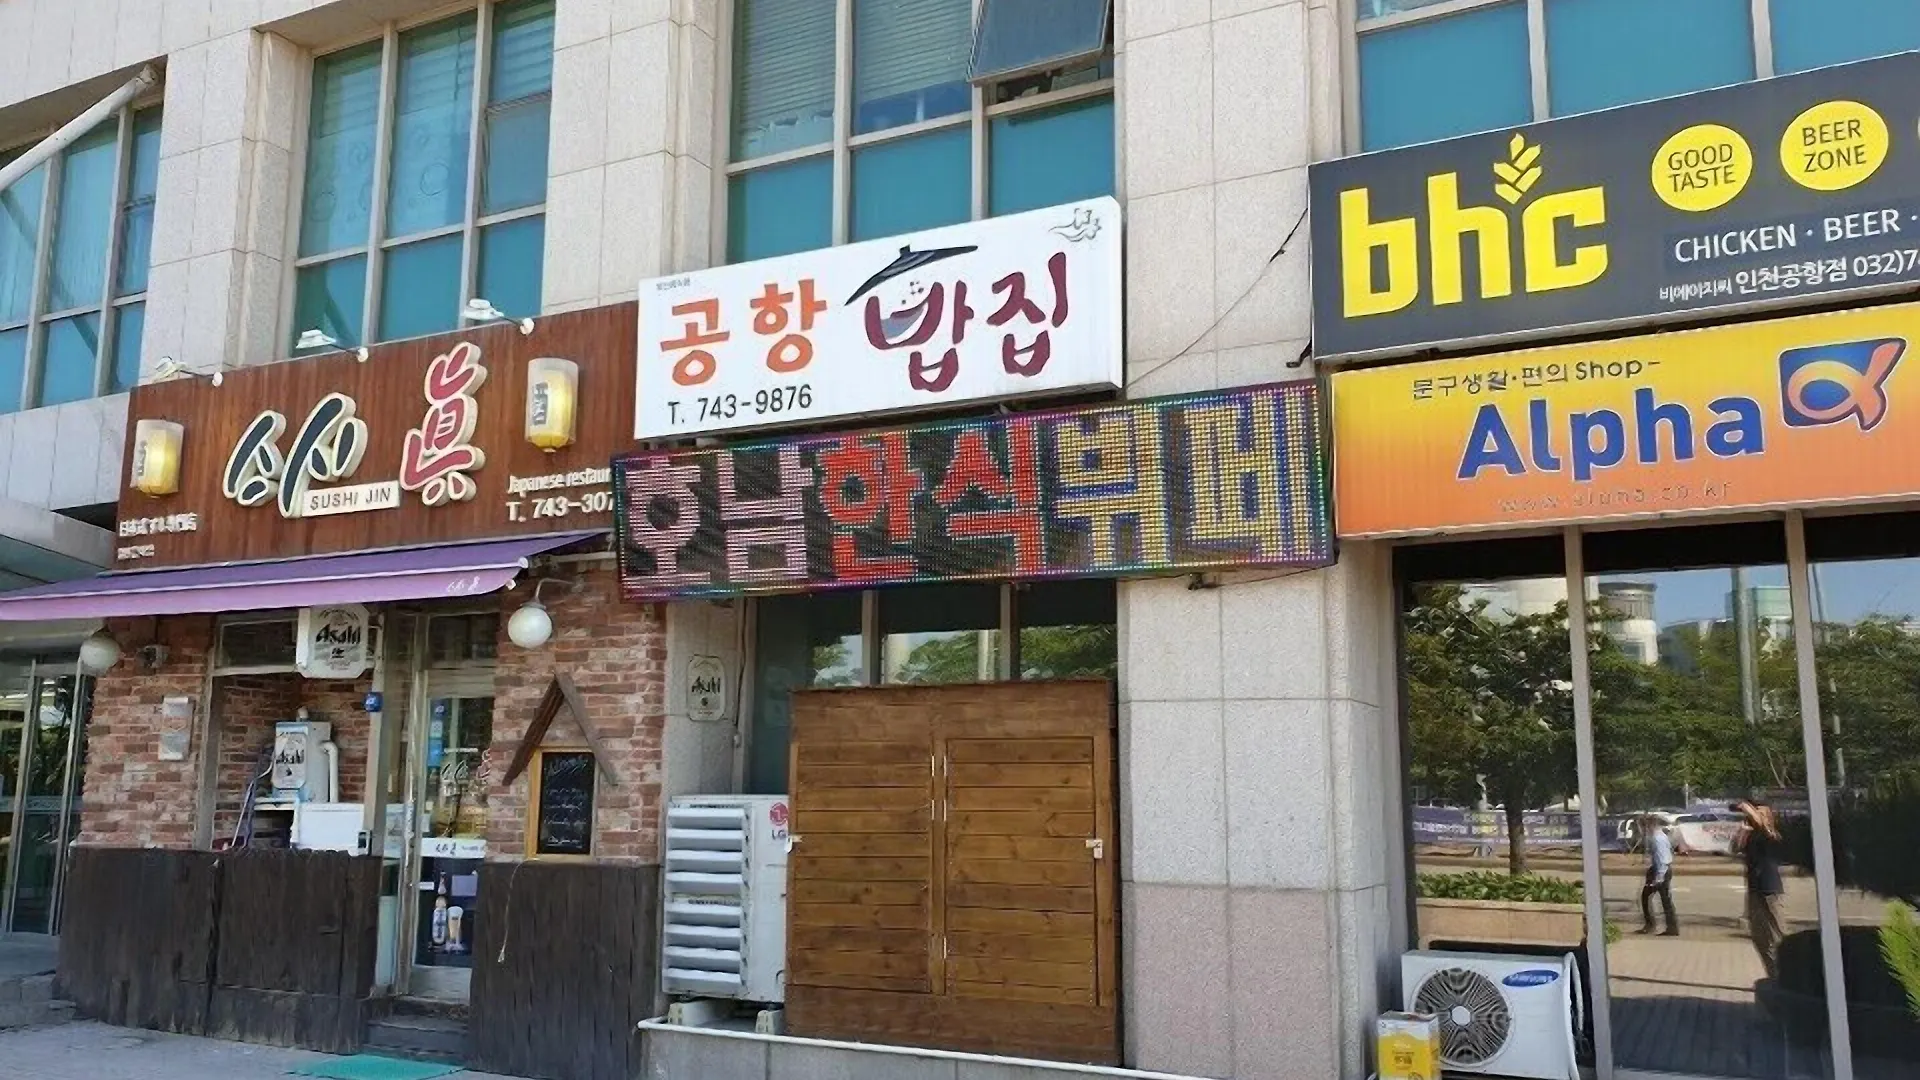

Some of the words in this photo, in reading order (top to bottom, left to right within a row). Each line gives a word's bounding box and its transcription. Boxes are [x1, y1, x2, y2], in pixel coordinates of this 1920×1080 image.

[1801, 119, 1862, 147] BEER
[1667, 142, 1734, 172] GOOD
[1803, 145, 1868, 174] ZONE
[1668, 166, 1736, 193] TASTE
[1340, 172, 1609, 318] bhc
[1674, 223, 1797, 263] CHICKEN
[1823, 208, 1902, 242] BEER
[1735, 256, 1848, 295] 인천공항점
[1852, 248, 1920, 278] 032)7
[659, 278, 828, 388] 공항
[863, 250, 1070, 393] 밥집
[667, 400, 686, 426] T.
[696, 384, 813, 420] 743-9876
[1456, 386, 1765, 481] Alpha
[309, 492, 359, 511] SUSHI
[365, 487, 392, 503] JIN
[505, 501, 527, 523] T.
